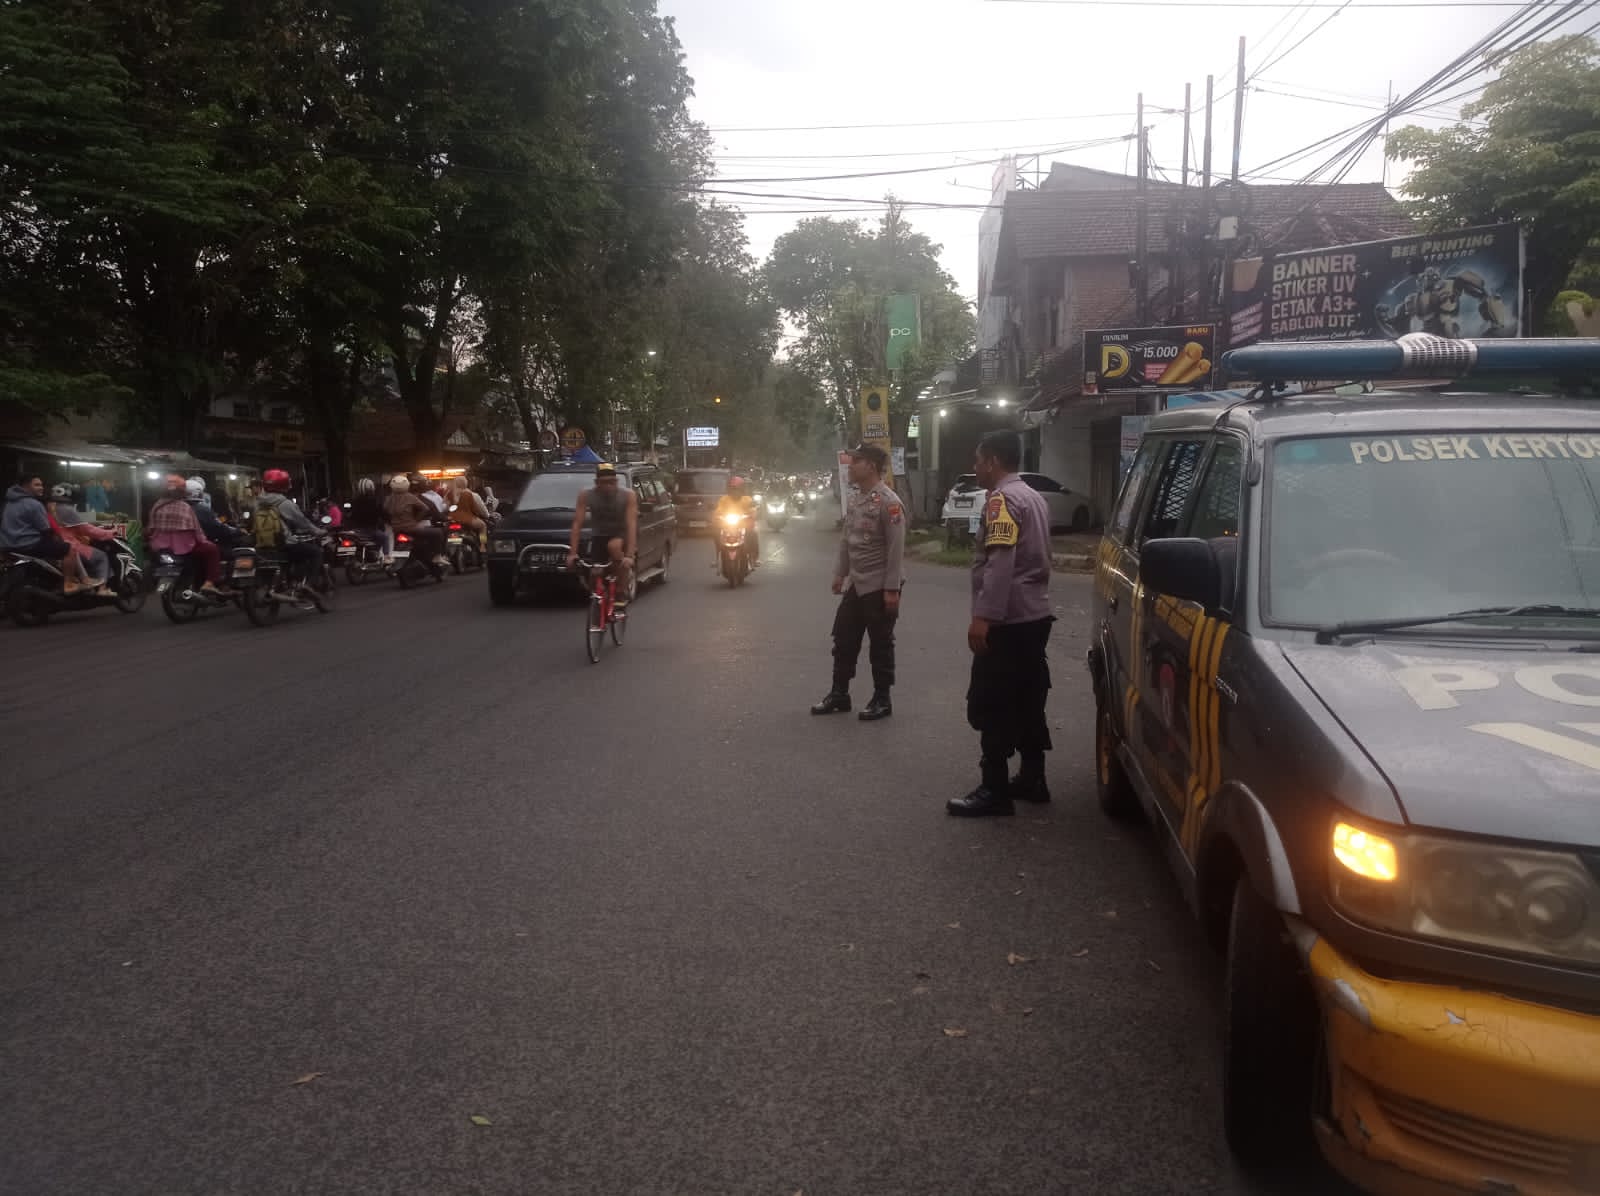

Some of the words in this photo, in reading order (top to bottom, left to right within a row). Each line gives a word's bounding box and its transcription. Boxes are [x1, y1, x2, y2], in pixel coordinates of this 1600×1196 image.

[1421, 234, 1496, 254] PRINTING
[1273, 254, 1357, 282] BANNER
[1272, 276, 1328, 301] STIKER
[1333, 274, 1357, 293] UV
[1271, 297, 1316, 319] CETAK
[1321, 295, 1357, 313] A3+
[1271, 315, 1324, 335] SABLON
[1328, 314, 1355, 328] DTF
[1143, 346, 1178, 358] 15.000
[1350, 436, 1480, 465] POLSEK
